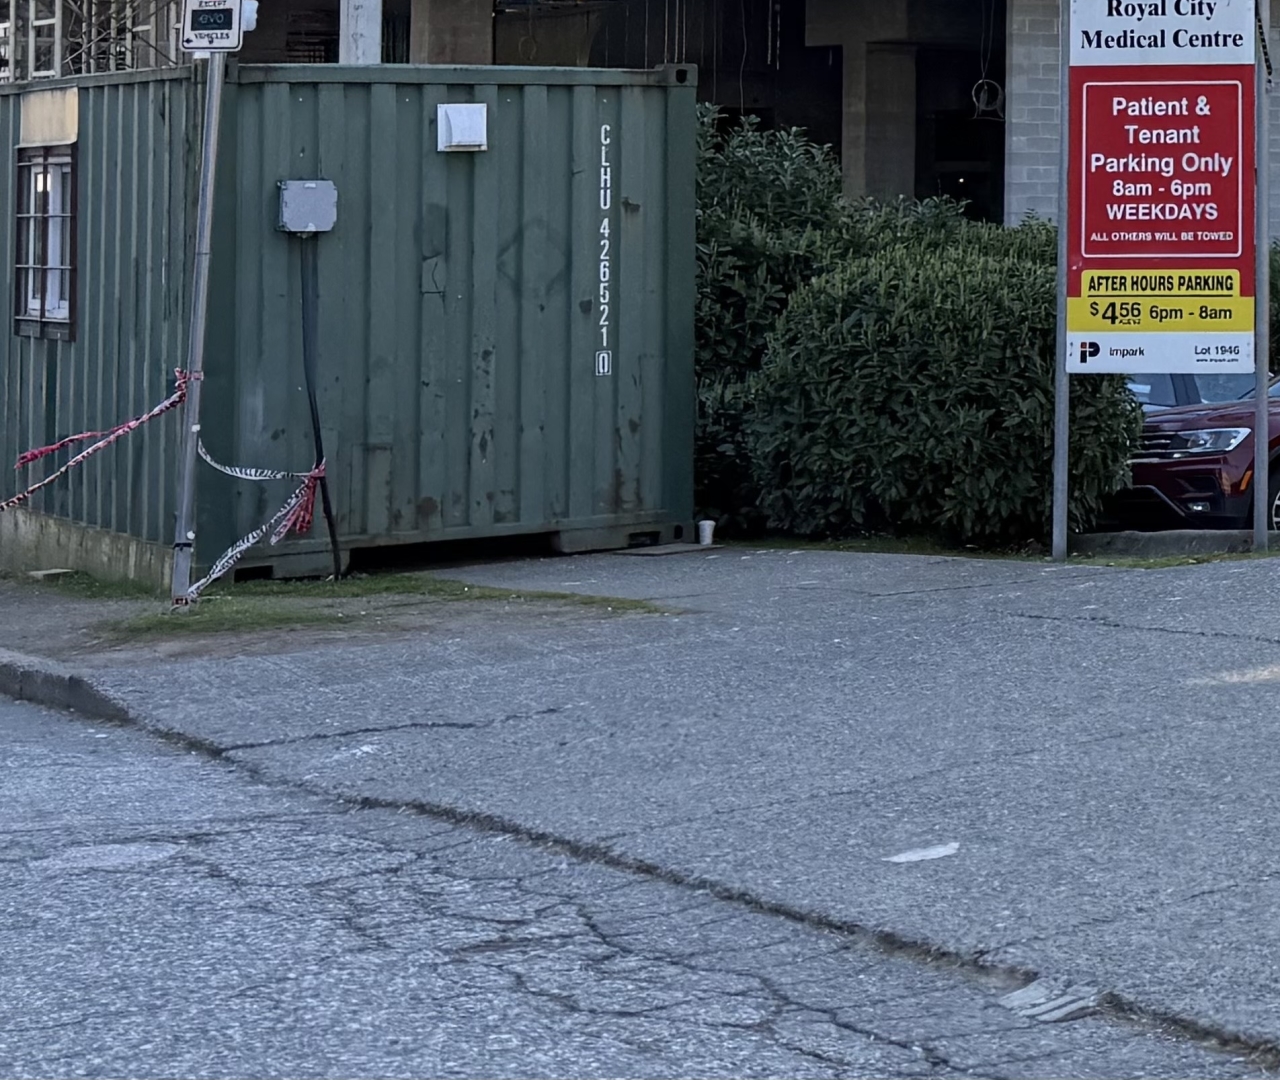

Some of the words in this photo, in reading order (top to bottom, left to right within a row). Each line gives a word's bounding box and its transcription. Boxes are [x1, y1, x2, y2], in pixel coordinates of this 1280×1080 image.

[1080, 29, 1166, 49] Medical
[1172, 28, 1244, 48] Centre
[1112, 96, 1188, 116] Patient
[1195, 95, 1211, 116] &
[1124, 125, 1200, 144] Tenant
[600, 124, 611, 210] CLHU
[1091, 153, 1174, 177] Parking
[1181, 152, 1233, 177] Only
[1112, 180, 1152, 196] 8am
[1170, 180, 1212, 200] 6pm
[1106, 203, 1218, 220] WEEKDAYS
[1090, 232, 1109, 242] ALL
[1111, 232, 1152, 241] OTHERS
[1154, 232, 1178, 241] WILL
[1181, 232, 1194, 241] BE
[1197, 231, 1234, 241] TOWED
[599, 218, 610, 347] 426521
[1088, 275, 1127, 292] AFTER
[1131, 275, 1174, 292] HOURS
[1178, 275, 1234, 291] PARKING
[1149, 305, 1183, 323] 6pm
[1198, 305, 1233, 320] 8am
[1194, 345, 1211, 355] Lot
[1214, 345, 1240, 355] 1946
